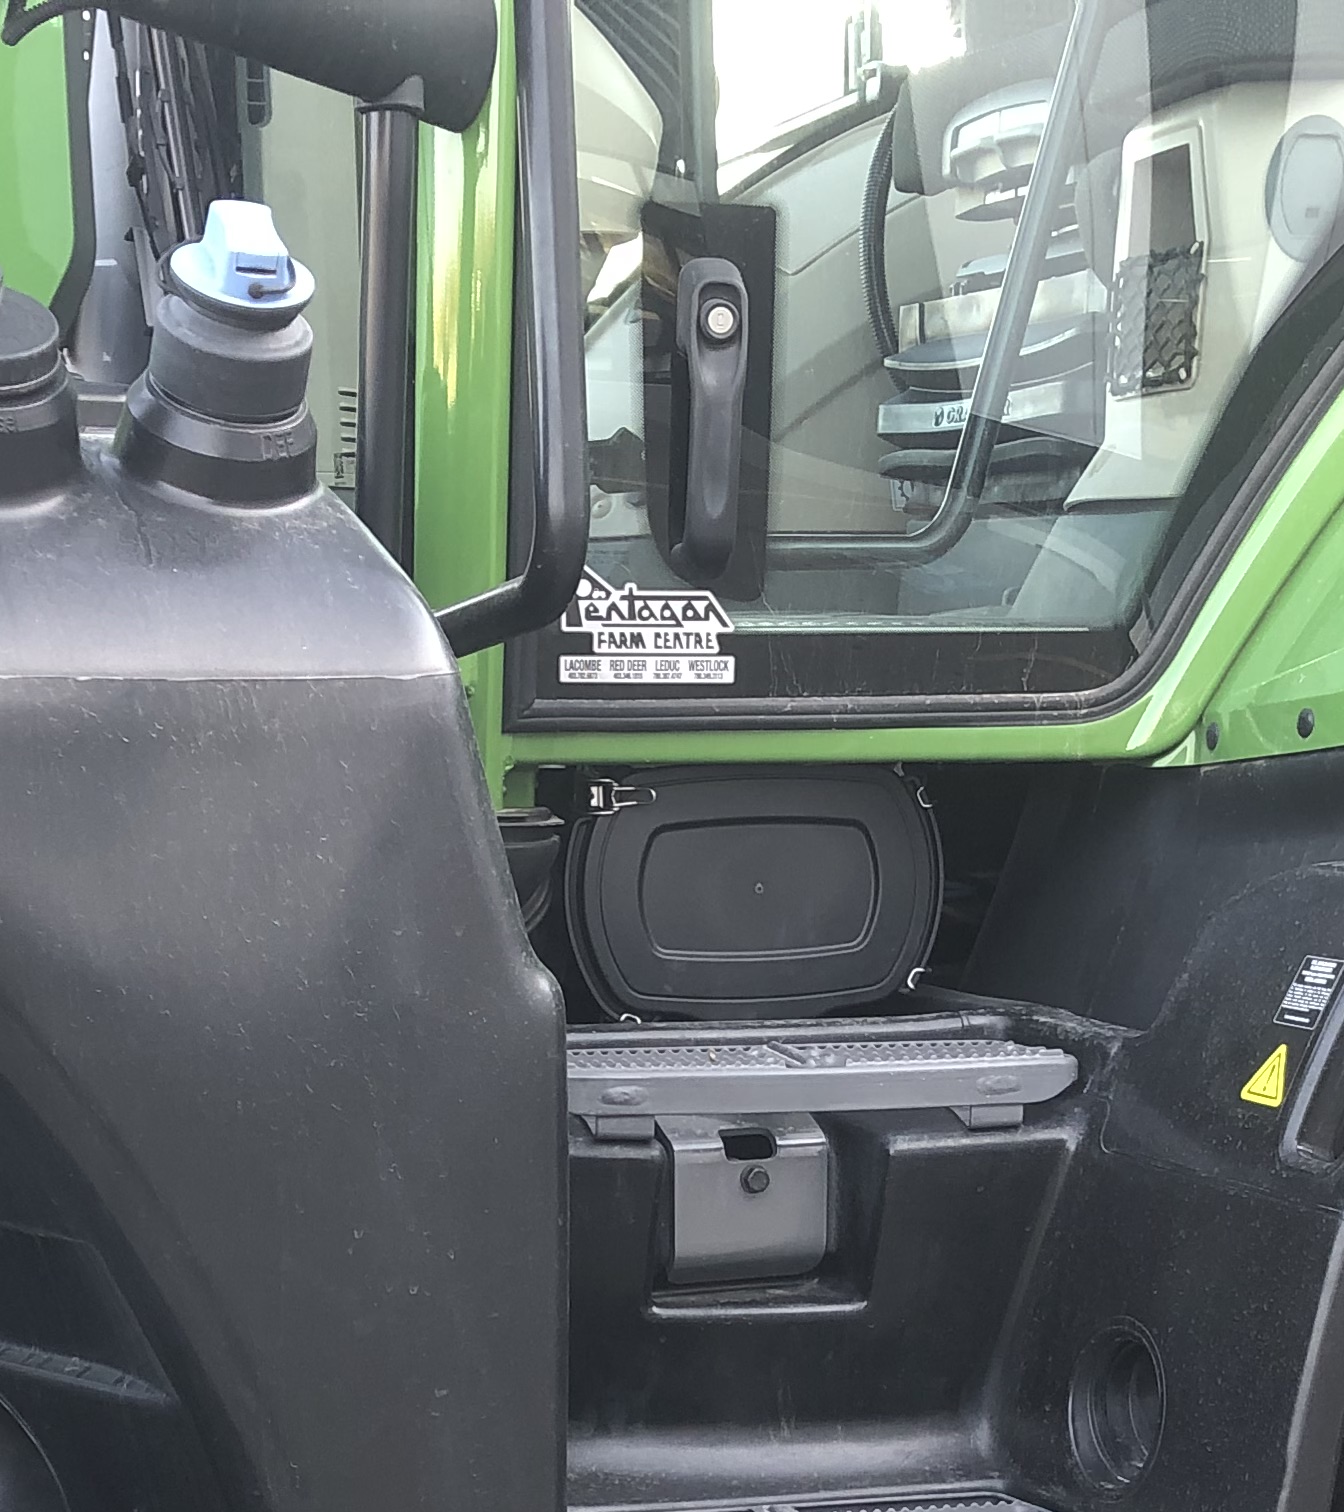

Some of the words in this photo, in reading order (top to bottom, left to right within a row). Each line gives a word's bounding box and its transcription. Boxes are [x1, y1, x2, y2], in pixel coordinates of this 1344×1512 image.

[261, 431, 294, 460] DEF
[597, 631, 646, 649] FARM
[654, 631, 715, 649] CENTRE
[564, 659, 602, 671] LACOMBE
[609, 659, 625, 671] RED
[627, 659, 647, 671] DEER
[655, 659, 680, 671] LEDUC
[688, 659, 729, 671] WESTLOCK
